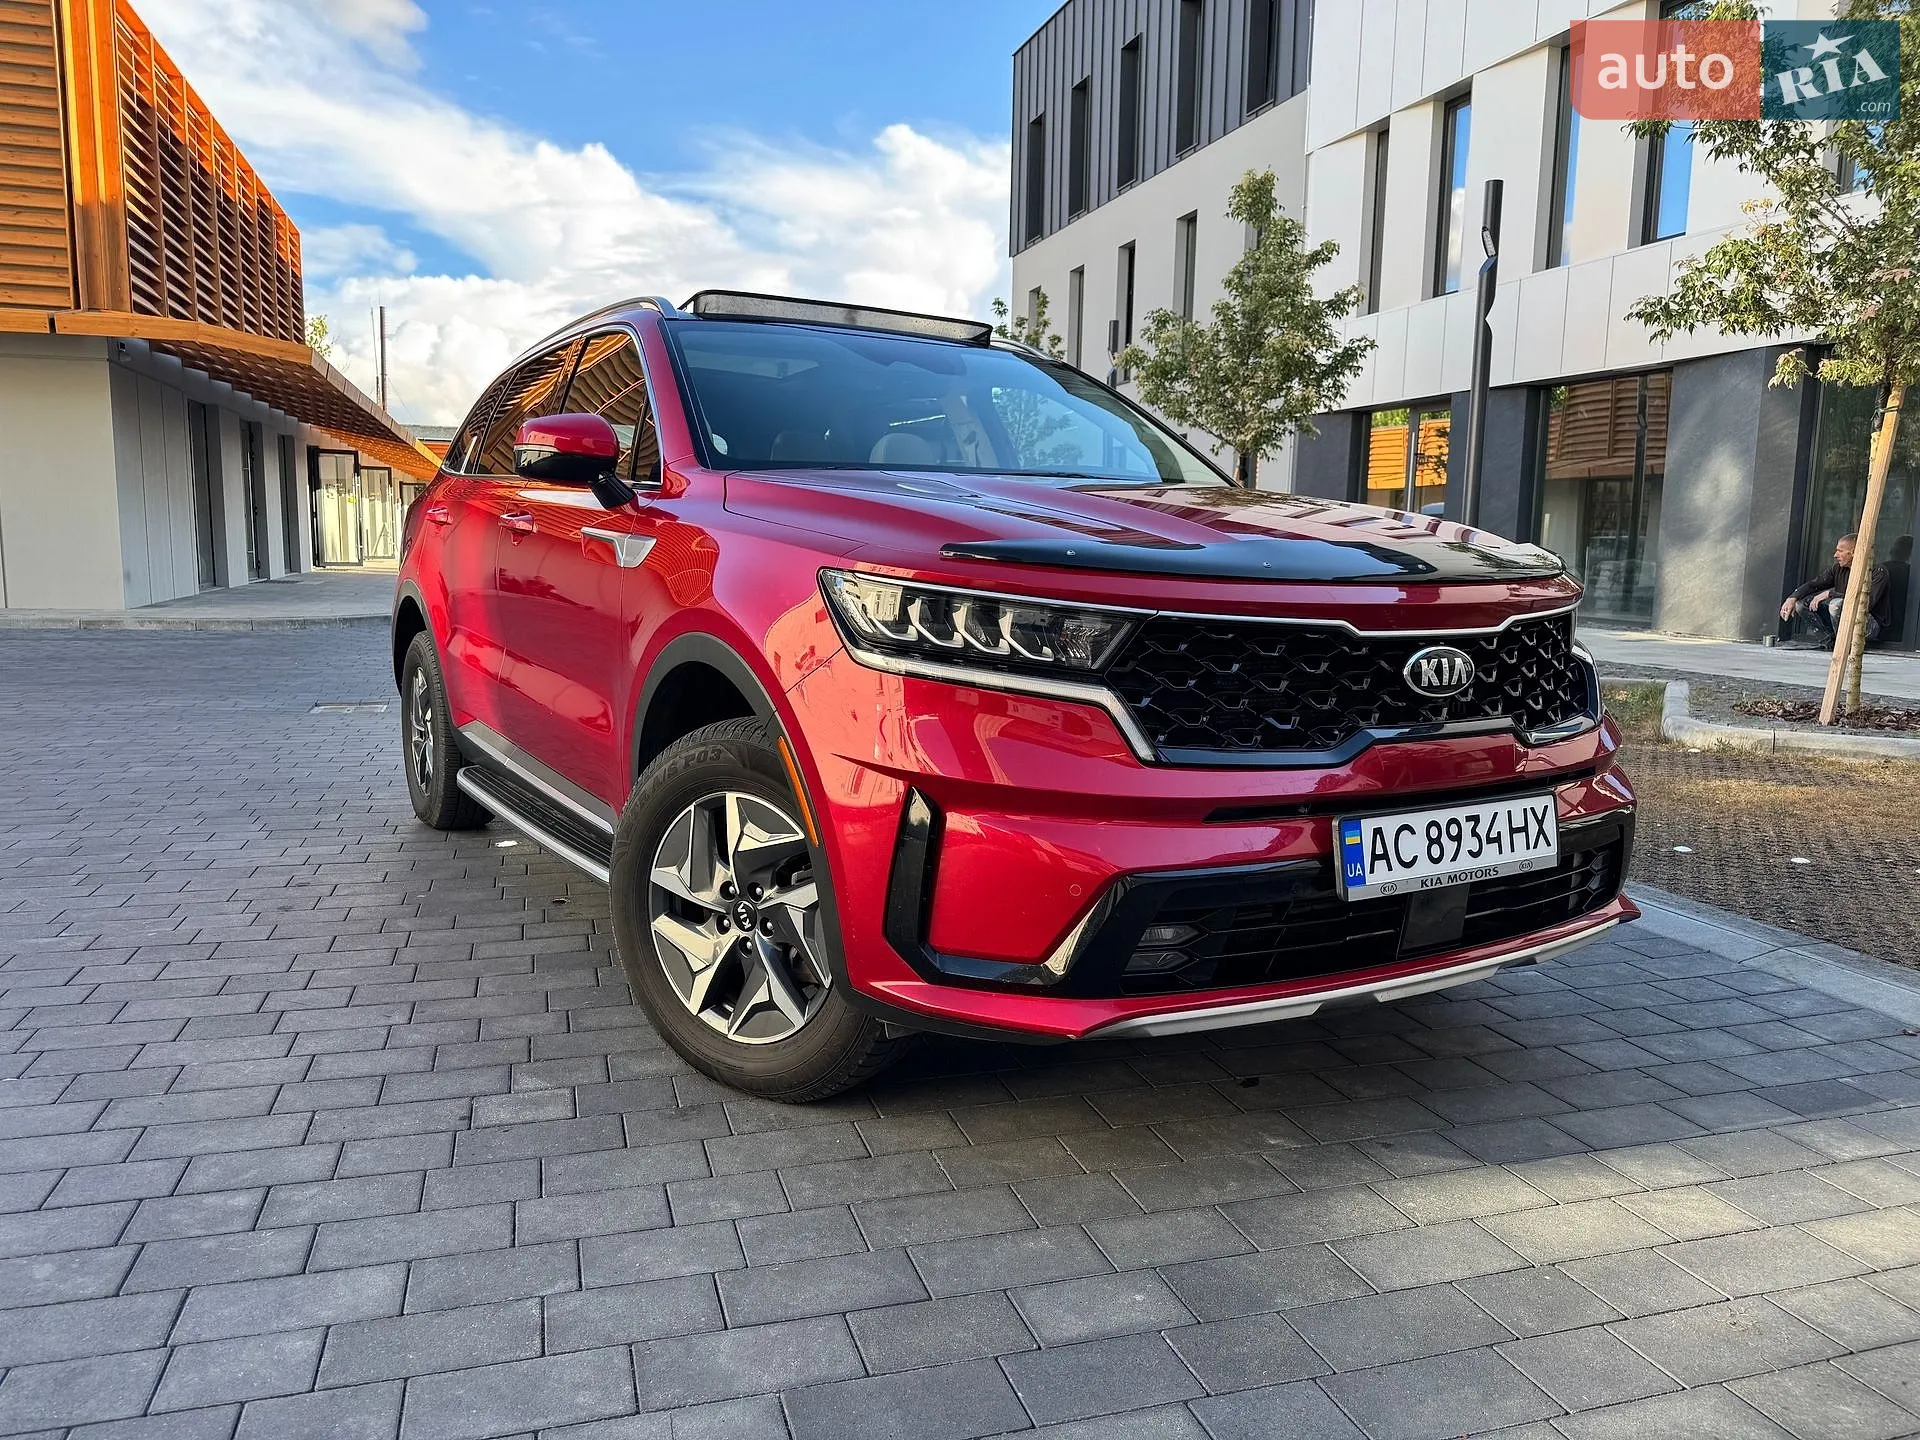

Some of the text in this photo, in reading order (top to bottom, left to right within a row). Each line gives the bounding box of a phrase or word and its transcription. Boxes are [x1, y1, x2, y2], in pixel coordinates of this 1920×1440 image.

[1419, 657, 1467, 687] KIA
[1347, 863, 1364, 877] UA
[1420, 866, 1499, 889] KIA MOTORS
[736, 902, 753, 930] KIA
